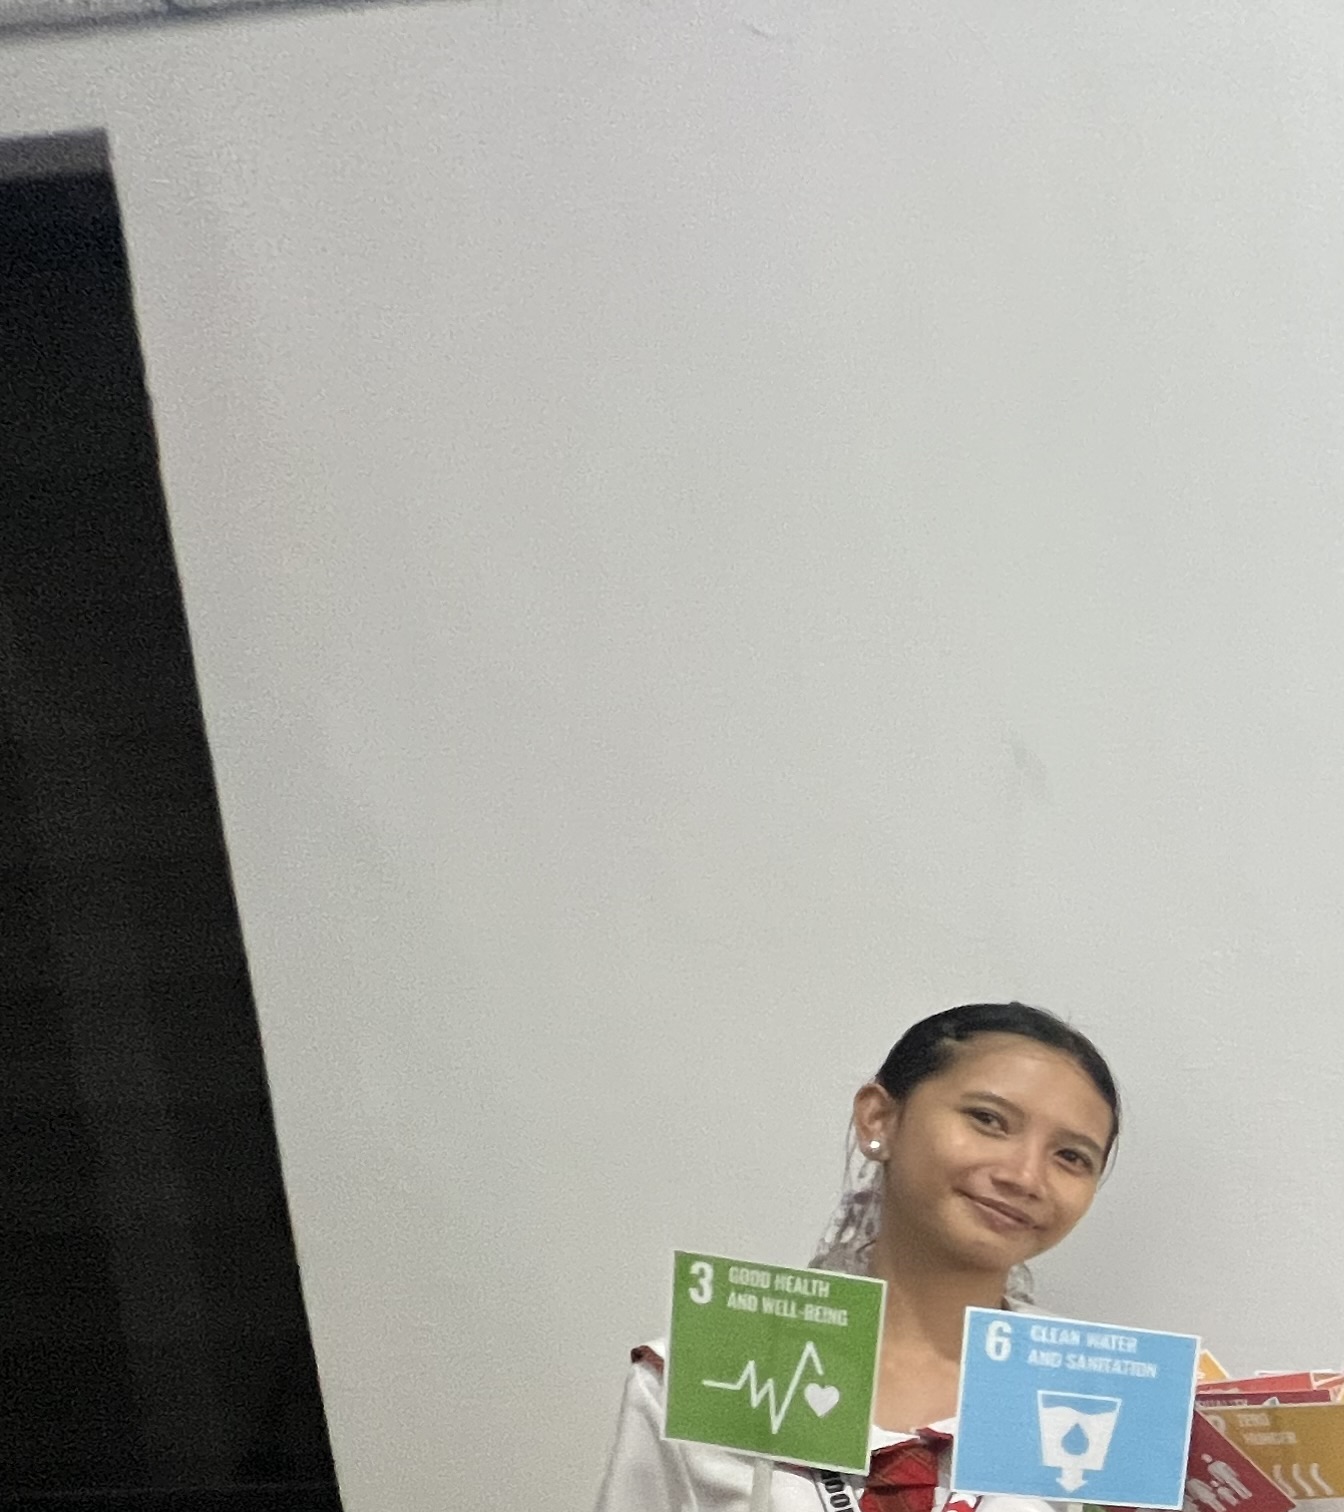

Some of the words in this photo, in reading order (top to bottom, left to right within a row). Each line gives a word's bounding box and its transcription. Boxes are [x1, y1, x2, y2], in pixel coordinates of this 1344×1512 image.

[689, 1261, 713, 1304] 3
[729, 1267, 771, 1291] GOOD
[775, 1272, 830, 1298] HEALTH
[727, 1292, 758, 1312] AND
[761, 1296, 849, 1327] WELL-BEING
[985, 1321, 1012, 1361] 6
[1030, 1326, 1082, 1346] CLEAN
[1087, 1331, 1138, 1353] WATER
[1028, 1349, 1062, 1369] AND
[1064, 1353, 1157, 1379] SANITATION
